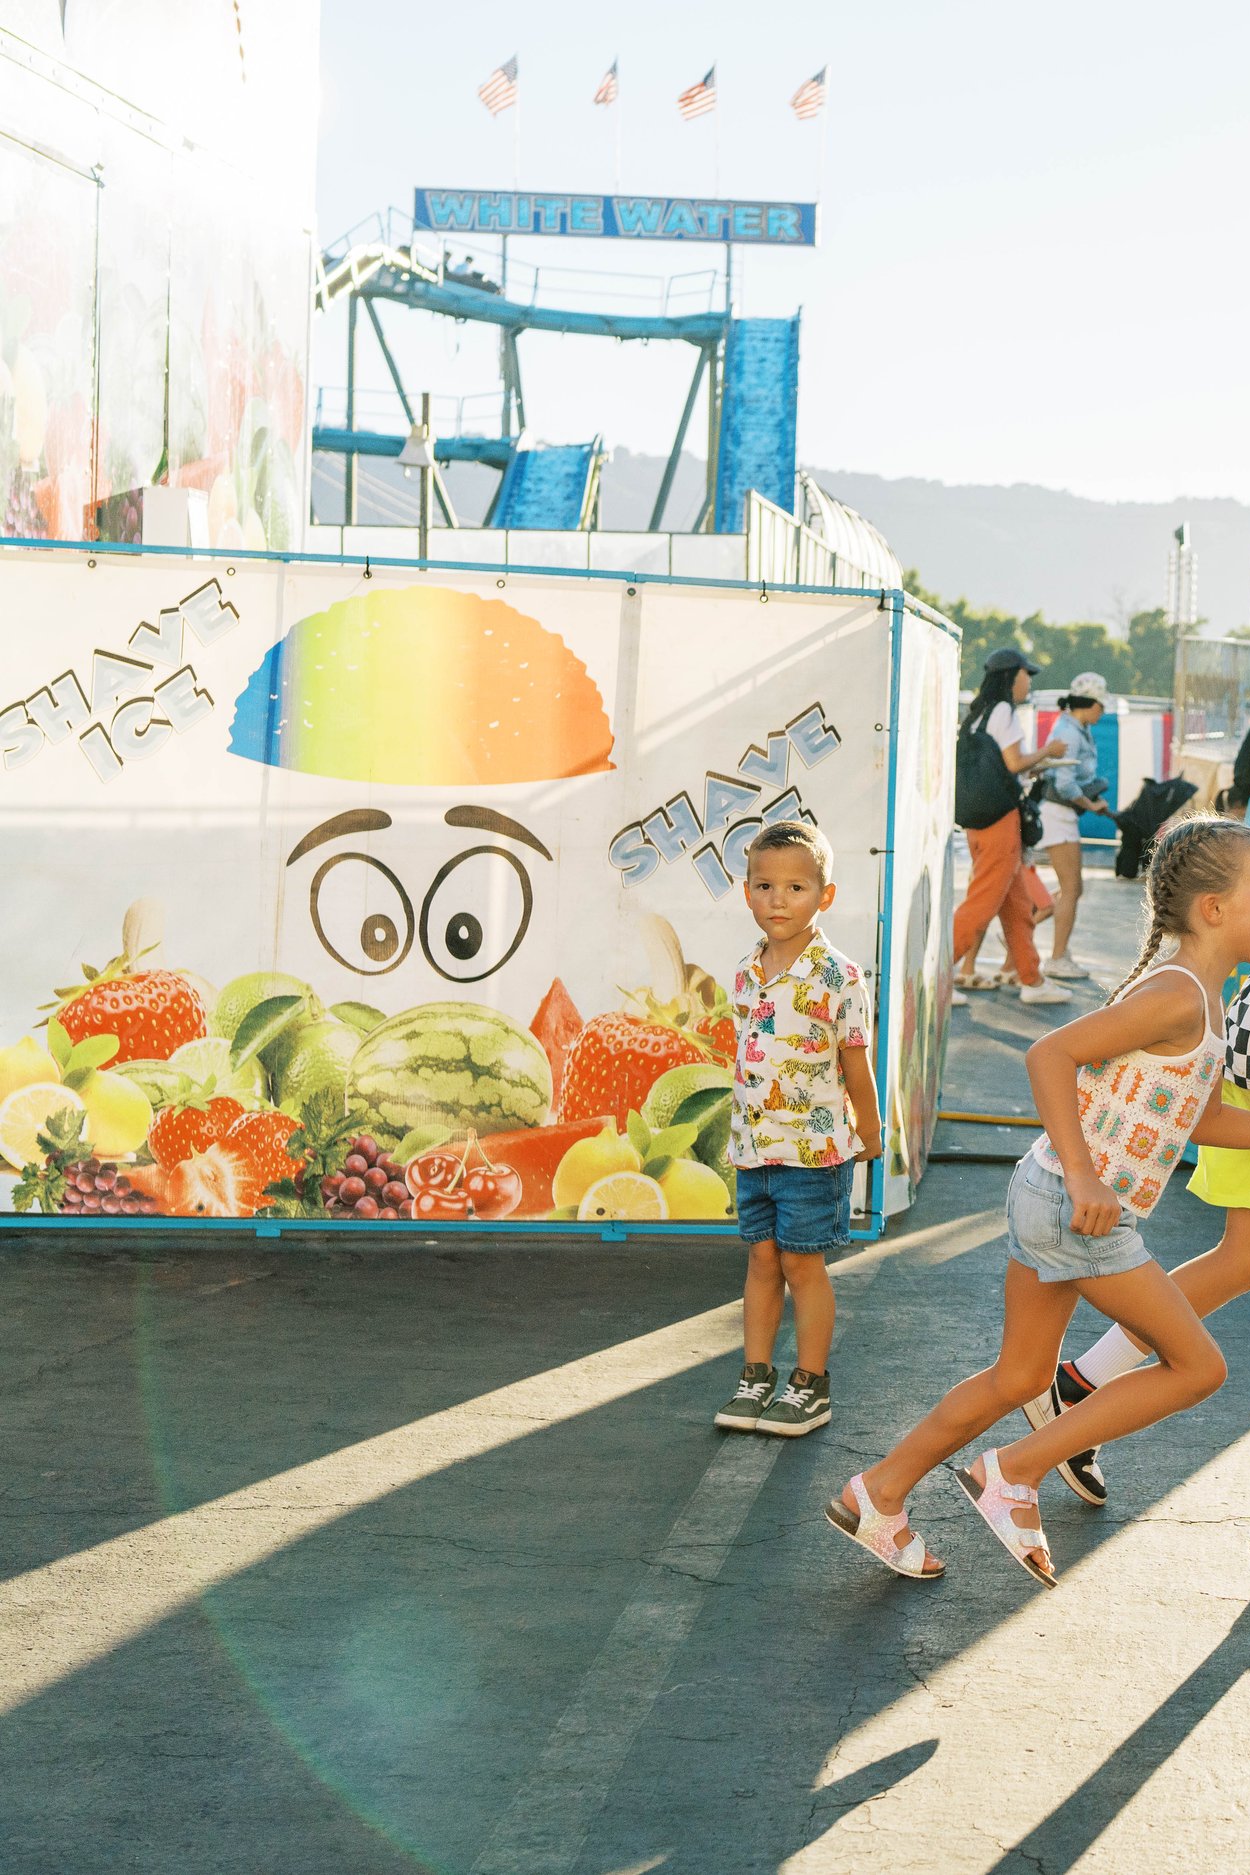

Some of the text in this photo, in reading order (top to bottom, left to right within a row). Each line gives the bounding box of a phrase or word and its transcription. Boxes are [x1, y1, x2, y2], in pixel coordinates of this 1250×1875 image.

[426, 190, 803, 242] WHITE WATER
[0, 577, 240, 771] SHAVE
[78, 664, 215, 784] ICE
[608, 701, 842, 889] SHAVE
